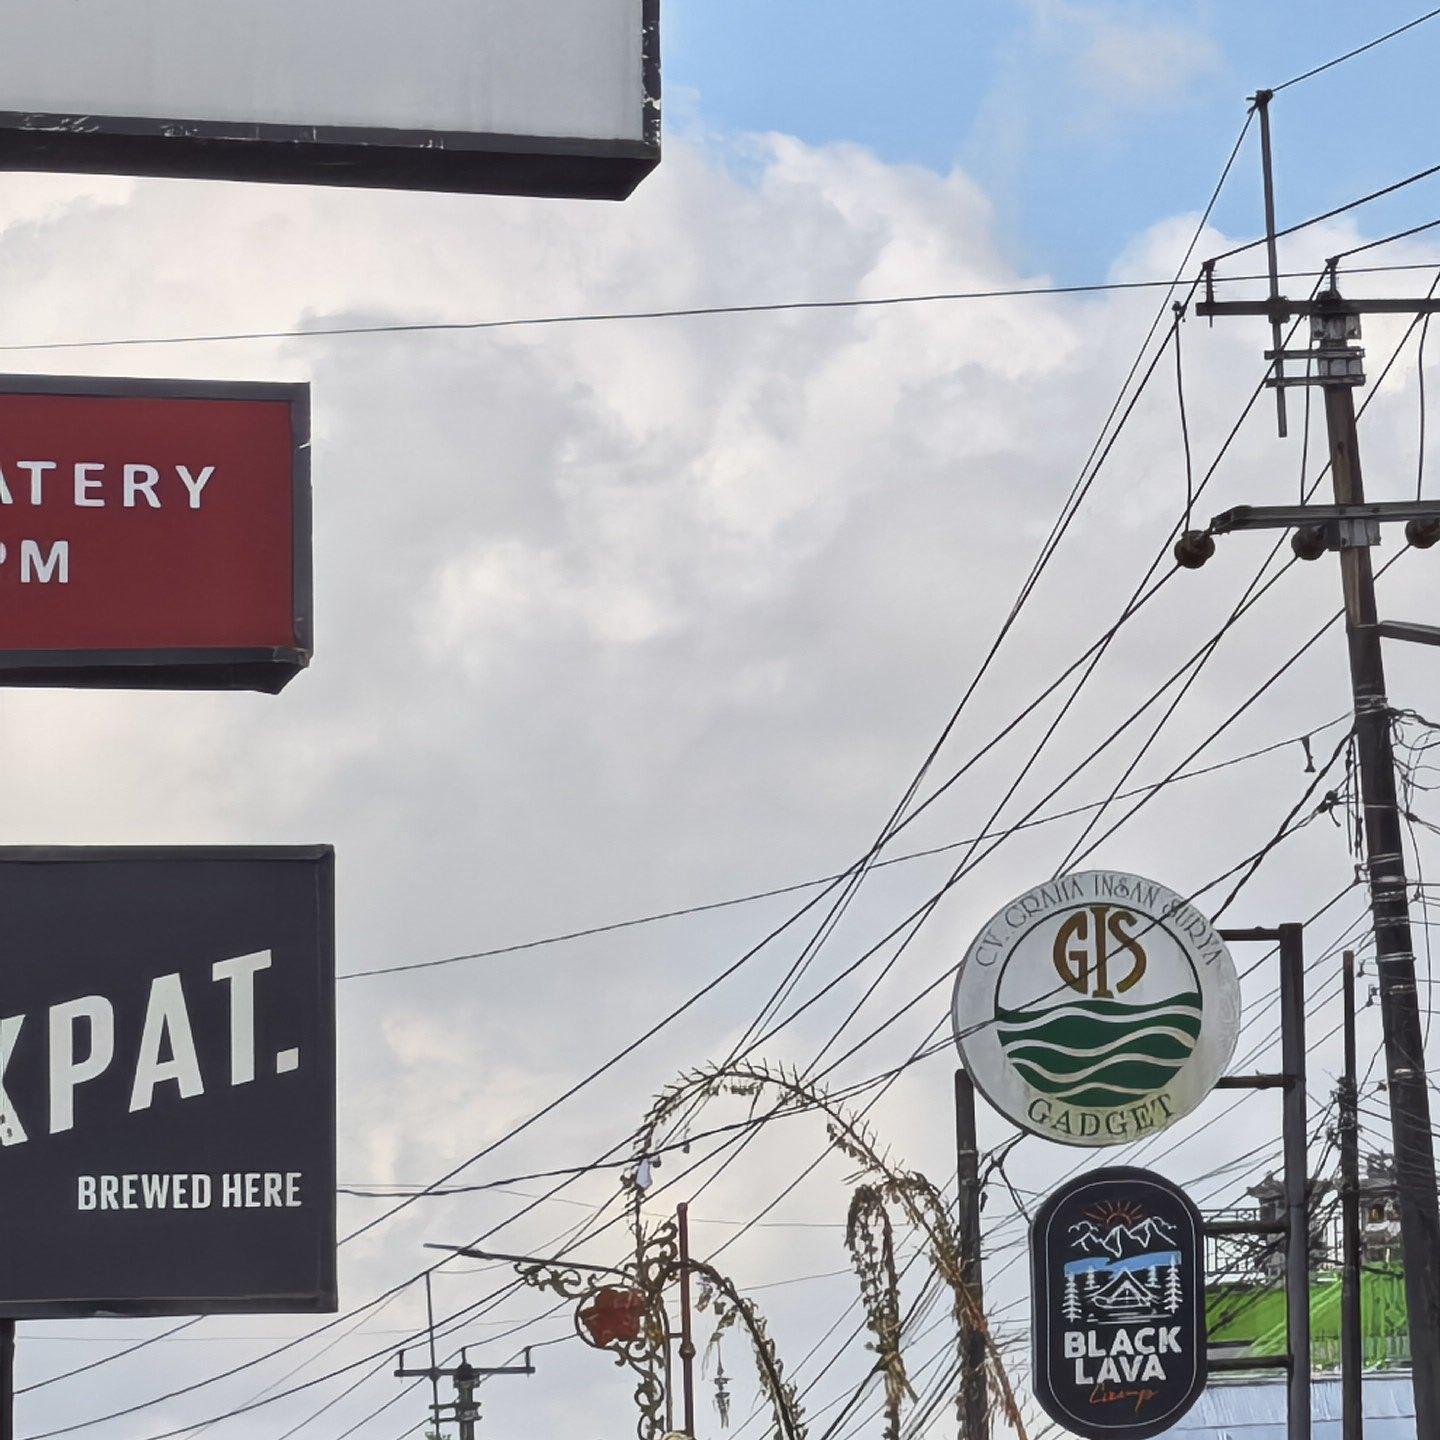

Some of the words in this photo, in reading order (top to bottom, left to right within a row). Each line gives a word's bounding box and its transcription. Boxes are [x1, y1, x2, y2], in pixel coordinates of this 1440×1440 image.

[0, 540, 68, 584] M
[1093, 872, 1160, 913] INSAN
[1053, 905, 1148, 999] GIS
[1027, 1093, 1174, 1137] GADGET
[77, 1174, 212, 1211] BREWED
[221, 1172, 303, 1209] HERE
[1064, 1325, 1182, 1358] BLACK
[1075, 1353, 1167, 1385] LAVA
